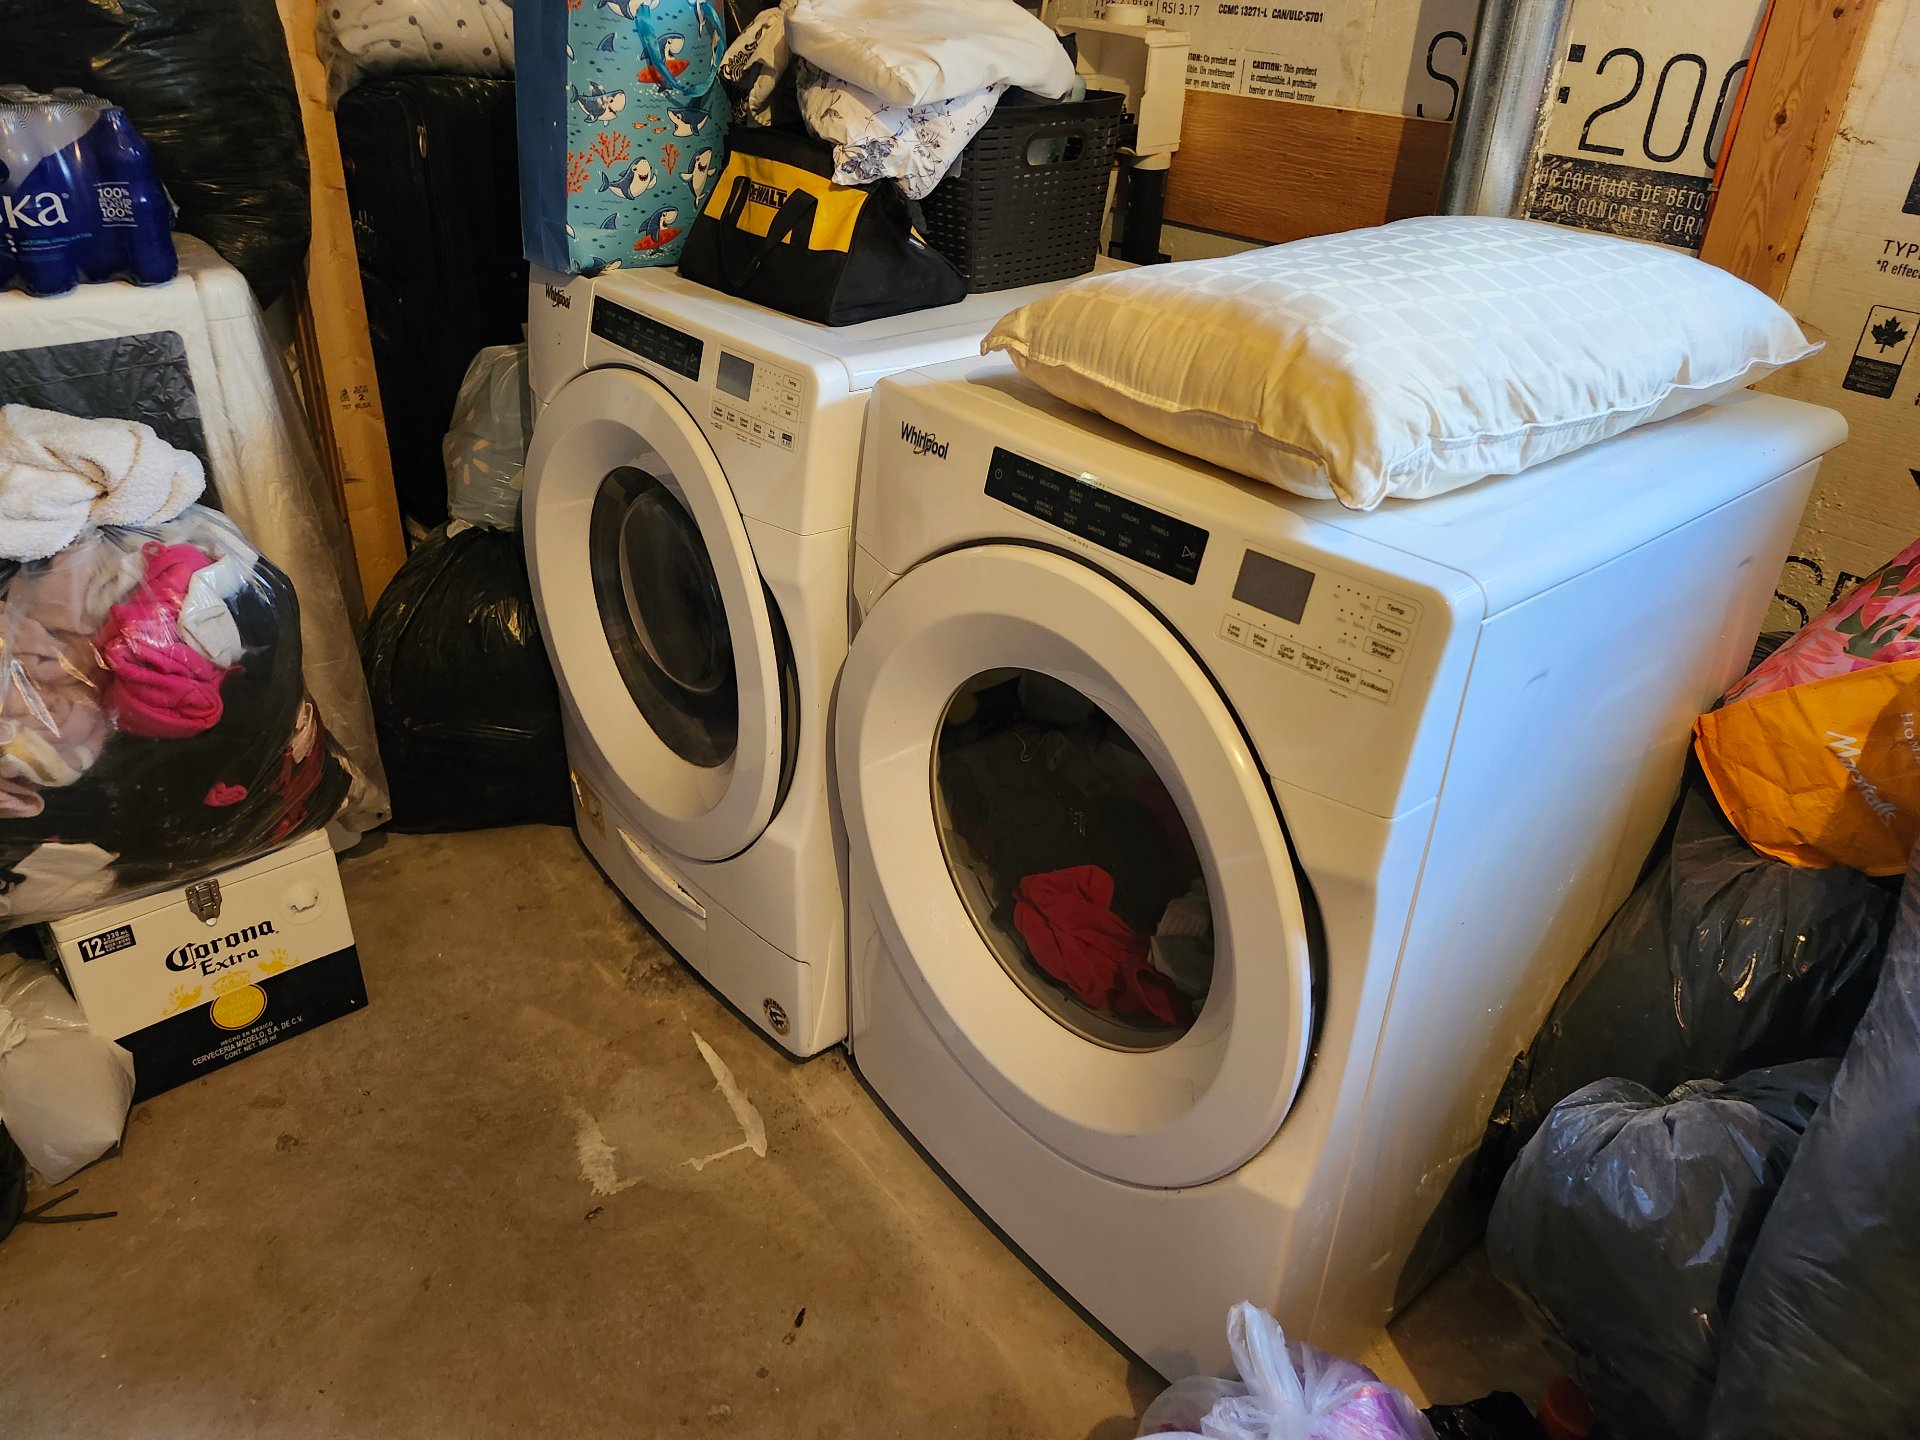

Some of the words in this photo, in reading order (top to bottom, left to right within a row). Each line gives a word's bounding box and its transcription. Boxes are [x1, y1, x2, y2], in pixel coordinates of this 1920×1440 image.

[1161, 2, 1177, 15] RSI
[1178, 3, 1200, 17] 3.17
[1218, 3, 1239, 15] CCMC
[1240, 5, 1268, 18] 13271-L
[1252, 60, 1282, 72] CAUTION:
[1283, 63, 1295, 74] This
[1295, 66, 1318, 77] product
[1250, 72, 1256, 81] is
[1248, 85, 1266, 96] barrier
[1267, 89, 1274, 97] or
[97, 187, 130, 198] 100%
[1562, 171, 1638, 200] COFFRAGE
[1642, 184, 1663, 203] DE
[0, 192, 69, 229] ka
[101, 208, 134, 218] 100%
[1541, 191, 1571, 212] FOR
[1576, 197, 1659, 228] CONCRETE
[545, 282, 572, 309] Whirlpool
[901, 421, 950, 460] Whirlpool
[1387, 603, 1405, 615] Temp
[1227, 628, 1240, 639] Time
[1228, 622, 1241, 633] Less
[1376, 622, 1402, 638] Dryness
[1252, 638, 1266, 649] Time
[1253, 632, 1268, 643] More
[1279, 643, 1295, 655] Cycle
[1371, 640, 1396, 654] Wrinkle
[1371, 647, 1392, 660] Shield
[1277, 649, 1295, 661] Signal
[1301, 652, 1319, 666] Damp
[1319, 657, 1330, 670] Dry
[1305, 660, 1323, 672] Signal
[1333, 666, 1357, 679] Control
[1335, 673, 1350, 684] Lock
[1825, 731, 1897, 826] Marshalls
[81, 936, 106, 959] 12
[165, 920, 275, 972] Corona
[200, 948, 259, 977] Extra
[192, 1042, 236, 1067] CERVECERIA
[236, 1031, 267, 1048] MODELO,
[281, 1021, 291, 1030] DE
[291, 1015, 304, 1025] C.V.
[220, 1034, 241, 1047] HECHO
[251, 1021, 273, 1034] MEXICO
[244, 1042, 258, 1053] NET.
